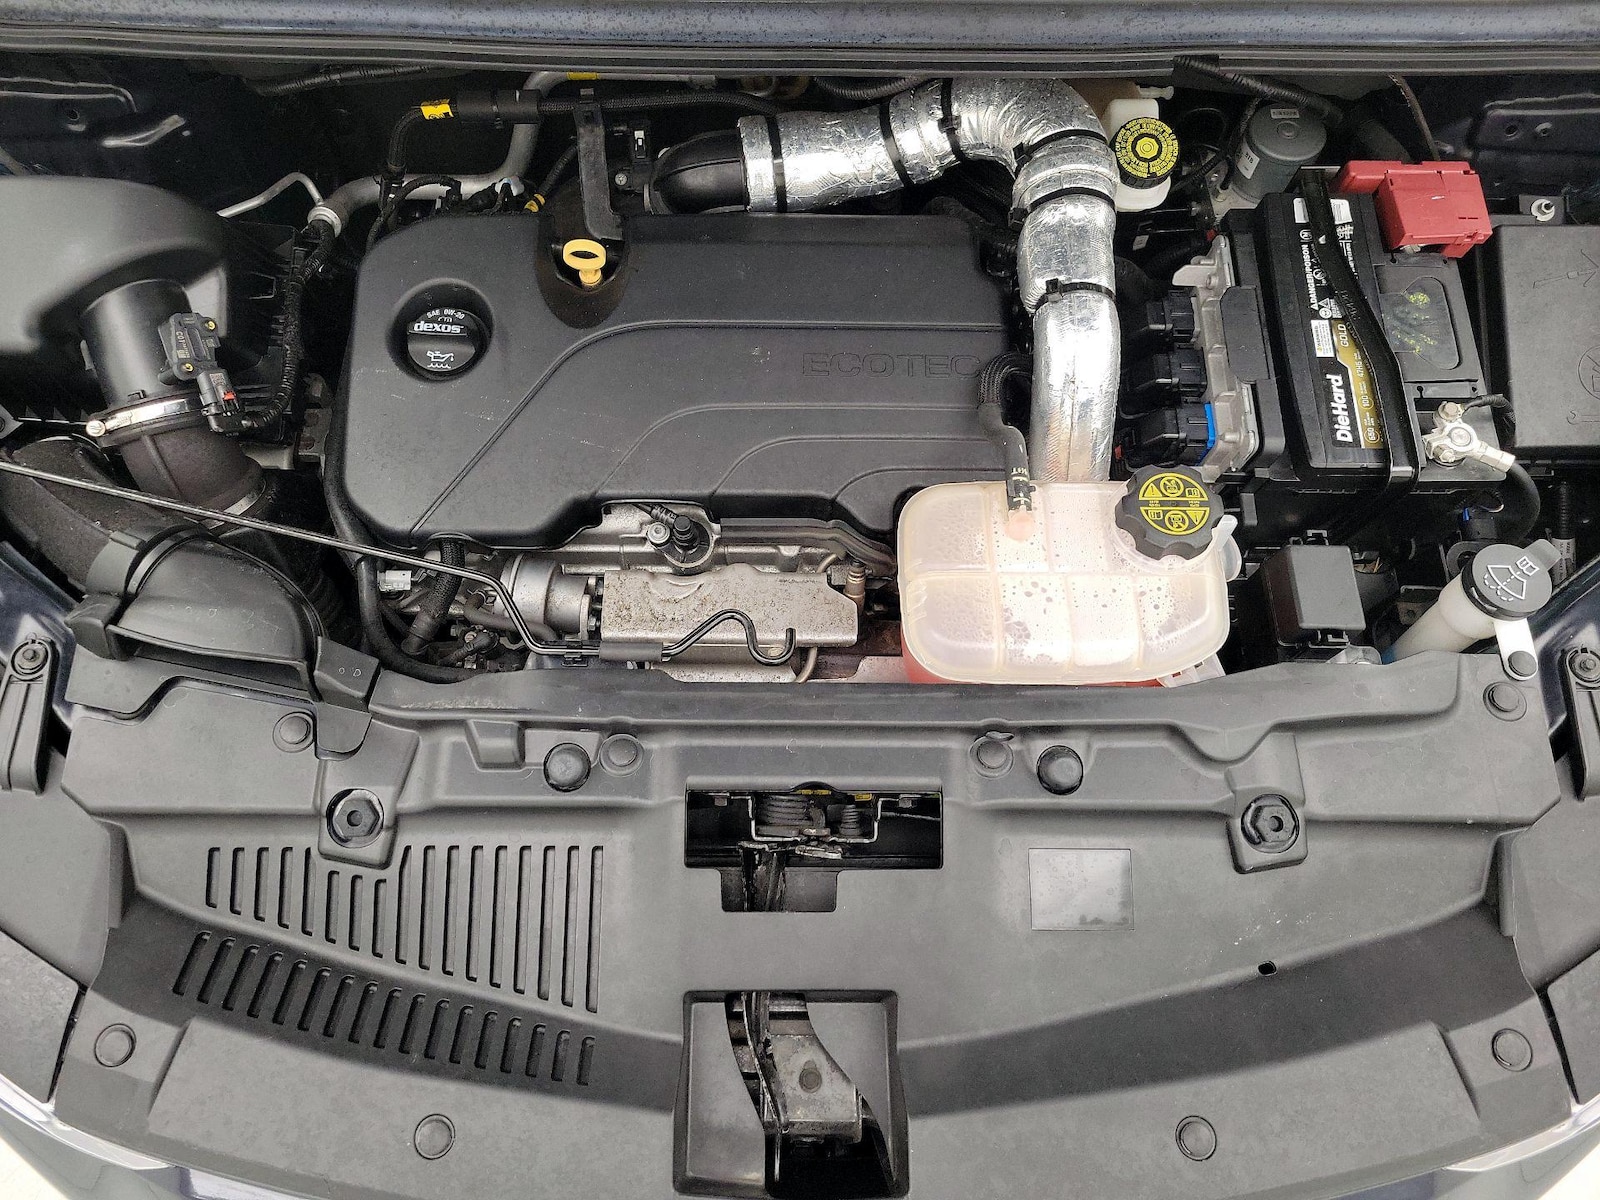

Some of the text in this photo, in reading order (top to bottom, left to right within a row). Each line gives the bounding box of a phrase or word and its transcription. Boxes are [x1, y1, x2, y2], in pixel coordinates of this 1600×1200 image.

[1301, 244, 1317, 303] DANGER/POISON
[413, 320, 463, 333] dexos
[426, 308, 465, 320] SAE 0W-20
[1337, 323, 1349, 347] GOLD
[802, 352, 982, 379] ECOTEC
[1326, 373, 1353, 443] DieHard
